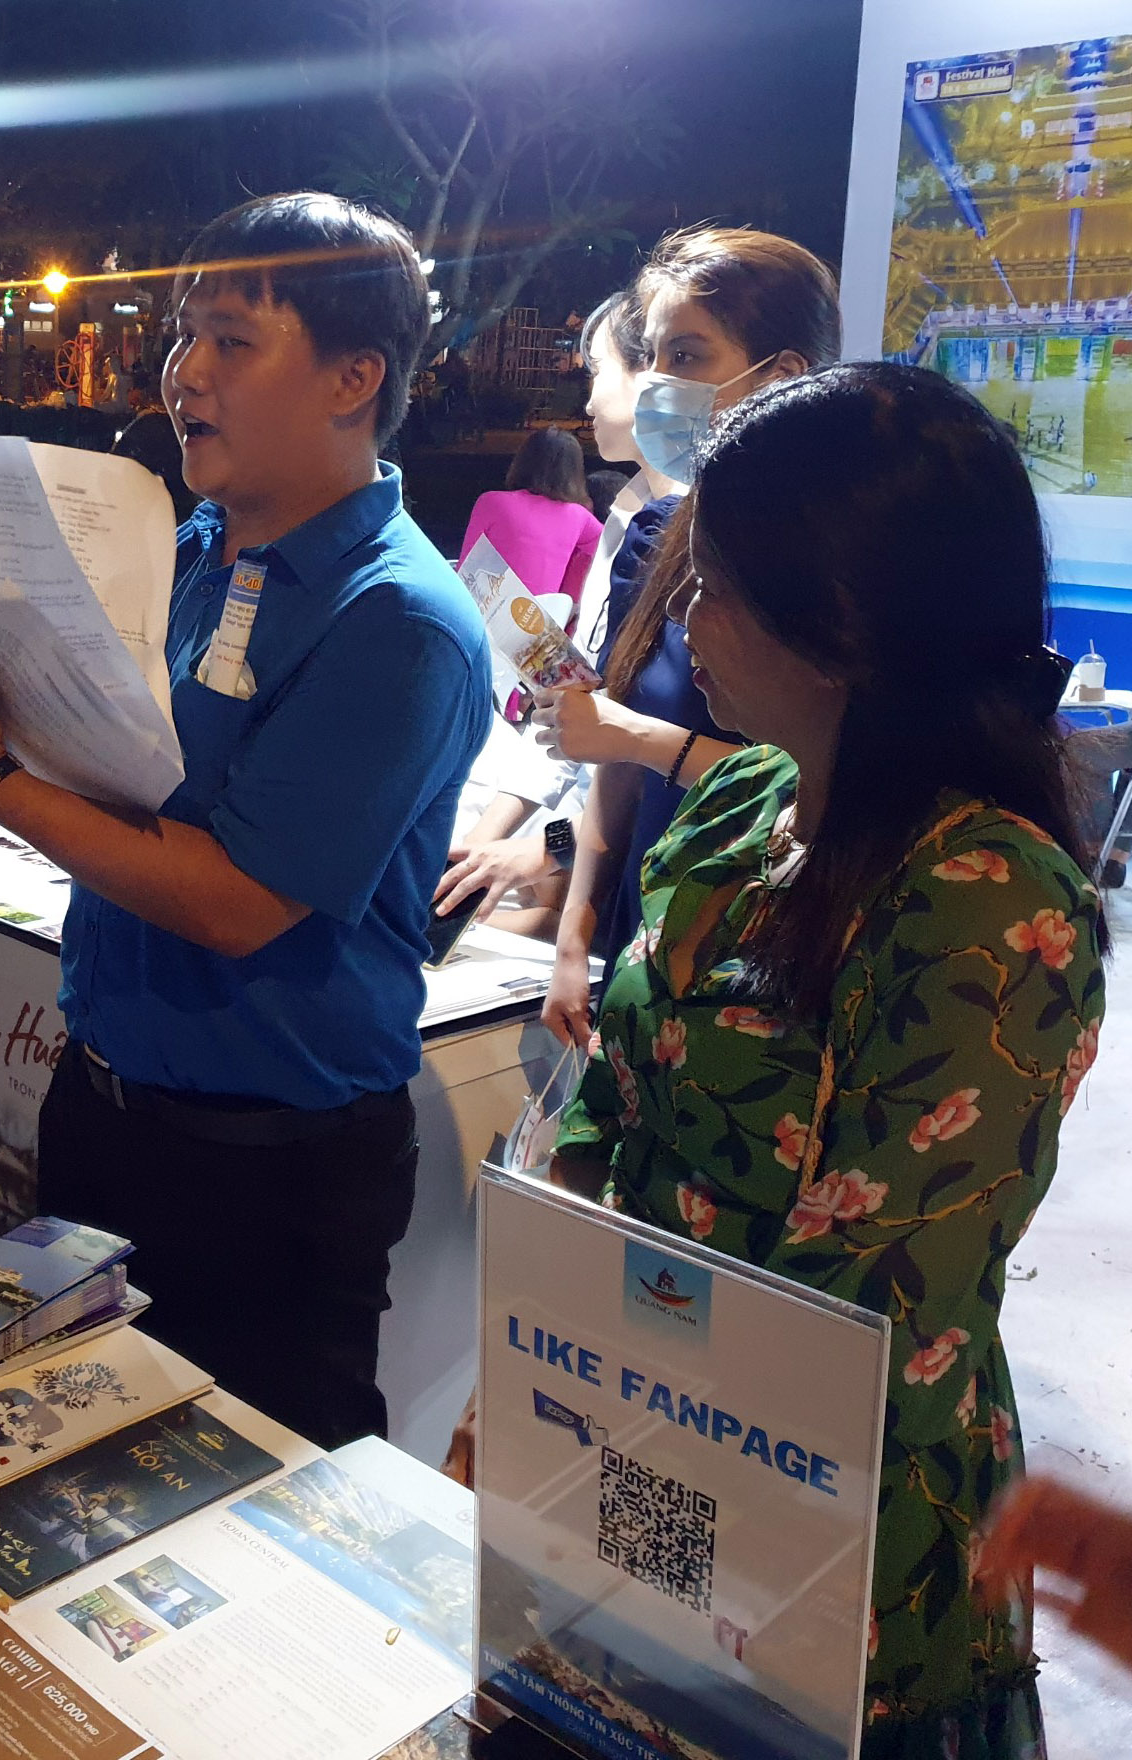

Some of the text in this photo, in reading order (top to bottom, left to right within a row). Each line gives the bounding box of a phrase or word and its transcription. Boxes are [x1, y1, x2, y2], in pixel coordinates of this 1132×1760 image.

[945, 67, 985, 82] Festival
[508, 1315, 840, 1498] LIKE FANPAGE
[158, 1471, 191, 1493] AN
[248, 1540, 290, 1569] CENTRAL
[1, 1638, 43, 1673] COMBO
[15, 1674, 28, 1682] 1
[483, 1650, 519, 1680] TRUNG
[587, 1713, 608, 1735] TIN
[42, 1685, 88, 1722] 625,000
